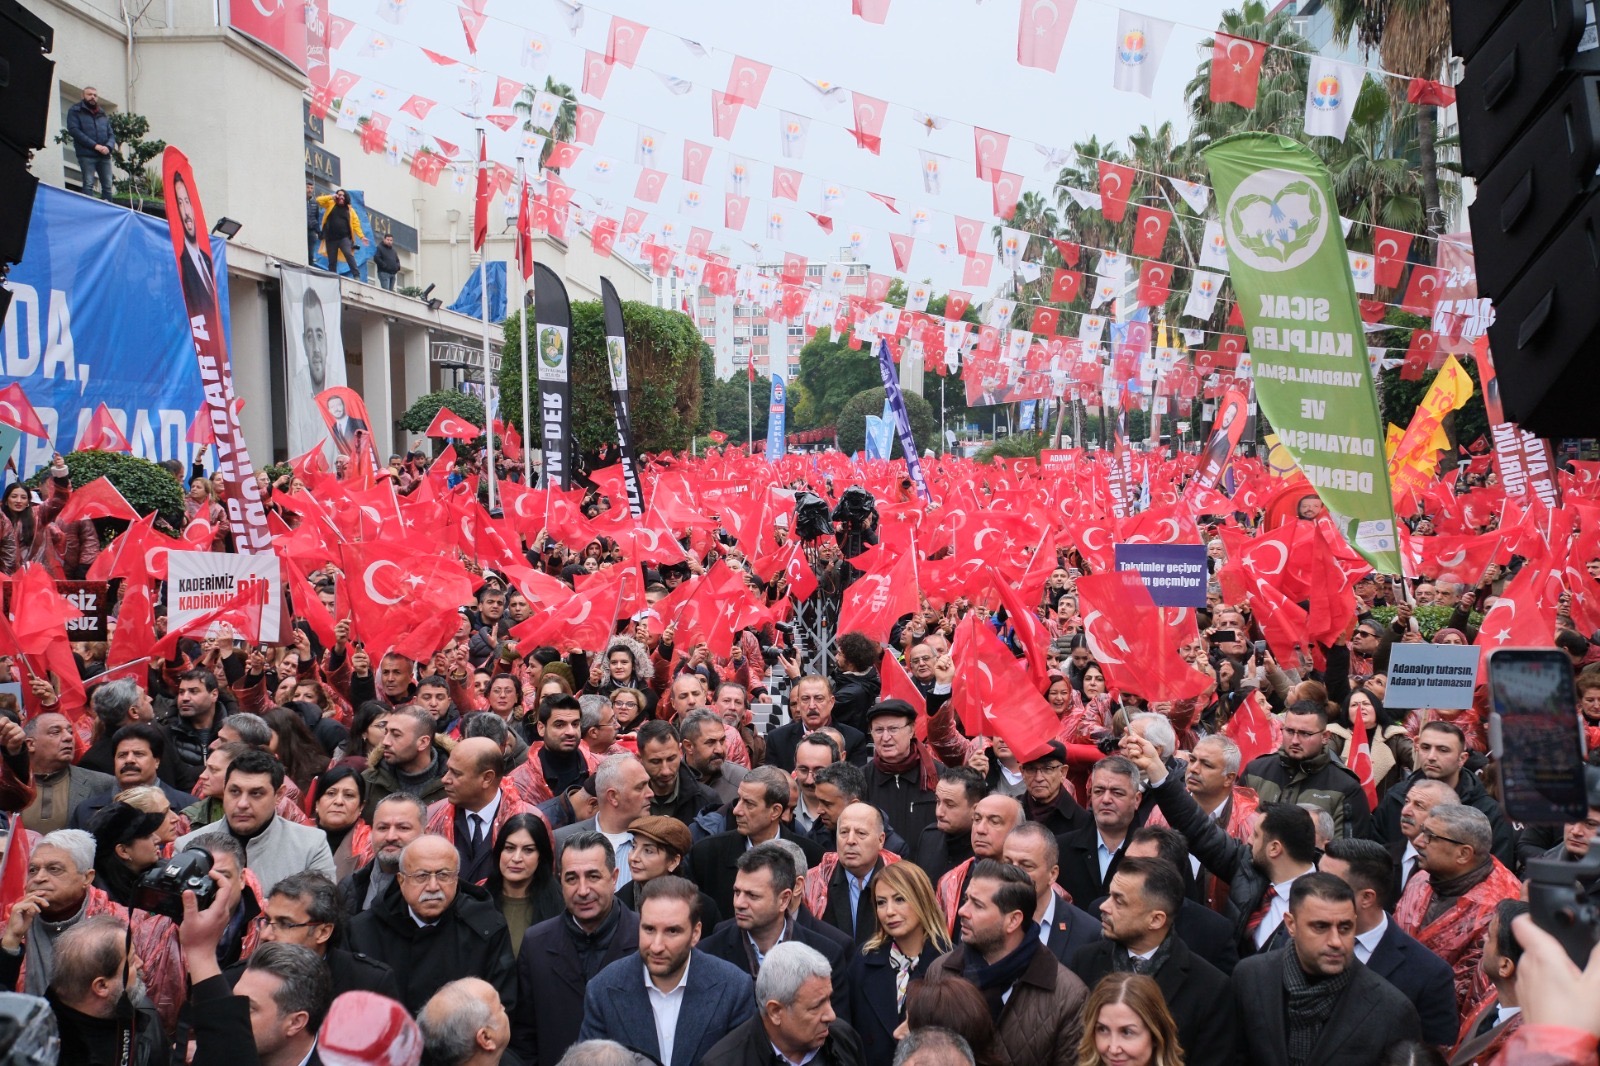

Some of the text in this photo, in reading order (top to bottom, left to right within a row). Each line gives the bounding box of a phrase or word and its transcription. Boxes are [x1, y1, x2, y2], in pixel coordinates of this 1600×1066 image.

[305, 147, 334, 177] ANA
[1166, 563, 1202, 574] geçiyor
[178, 573, 234, 592] KADERİMİZ
[1152, 576, 1201, 588] geçmiyor
[62, 588, 97, 611] SİZ
[178, 591, 234, 610] KADİRİMİZ
[65, 616, 98, 631] SUZ
[1392, 663, 1474, 676] Adanalıyı tutarsın,
[1390, 677, 1473, 688] Adana'yı tutamazsın
[121, 1029, 130, 1066] Canon
